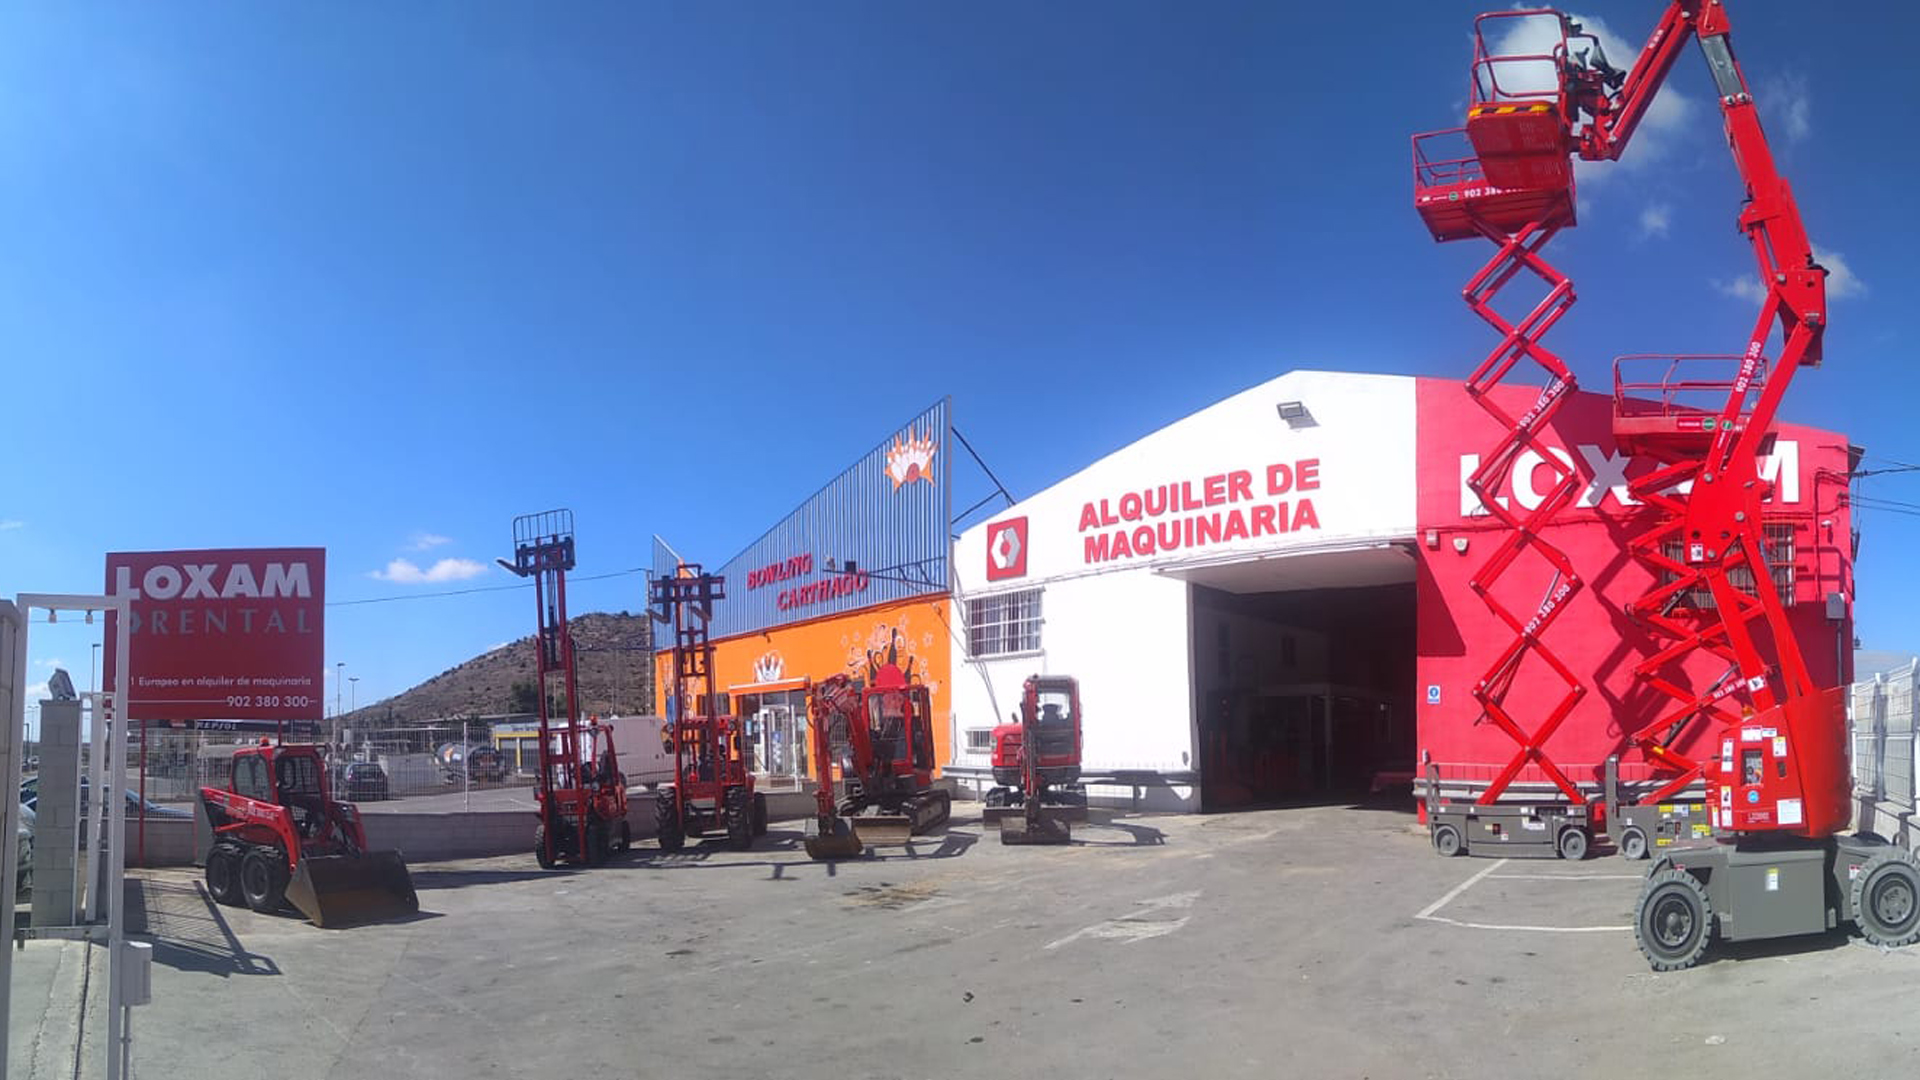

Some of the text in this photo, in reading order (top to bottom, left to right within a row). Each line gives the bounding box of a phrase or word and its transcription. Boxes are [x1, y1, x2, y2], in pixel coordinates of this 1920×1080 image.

[1079, 458, 1320, 532] ALQUILER DE
[1084, 499, 1321, 564] MAQUINARIA
[116, 563, 312, 600] LOXAM
[747, 552, 813, 591] BOWLING
[777, 568, 869, 610] CARTHAGO
[152, 607, 312, 634] RENTAL
[138, 676, 180, 687] Europeo
[196, 675, 234, 687] alquiler
[237, 676, 250, 686] de
[253, 676, 312, 687] maquinaria
[227, 695, 309, 708] 902 380 300
